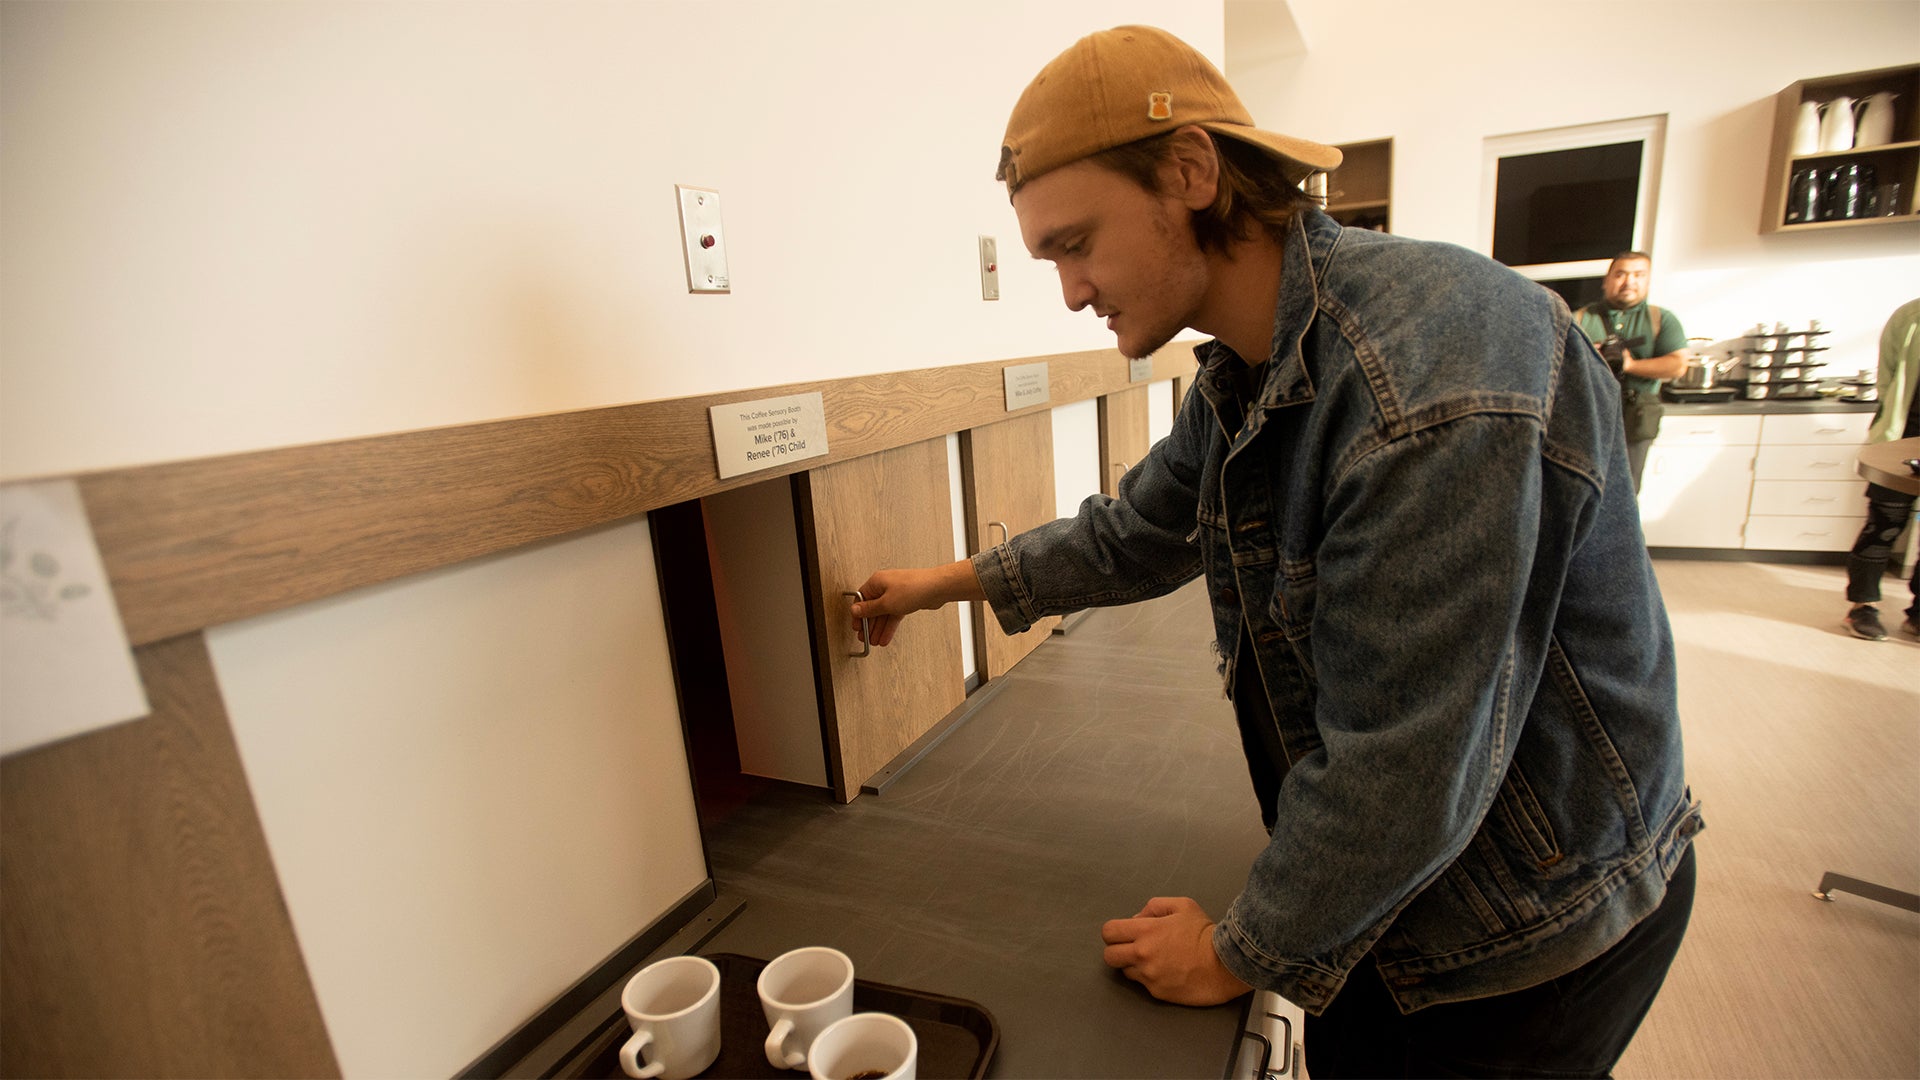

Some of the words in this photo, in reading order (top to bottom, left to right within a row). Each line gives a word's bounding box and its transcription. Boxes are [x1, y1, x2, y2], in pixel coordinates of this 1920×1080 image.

[751, 411, 767, 419] Coffee
[758, 422, 771, 430] made
[772, 418, 791, 427] possible
[792, 417, 797, 425] by
[754, 434, 772, 445] Mike
[774, 430, 789, 442] ('76)
[791, 428, 796, 438] &
[747, 450, 770, 461] Renee
[772, 444, 787, 457] ('76)
[788, 440, 806, 452] Child
